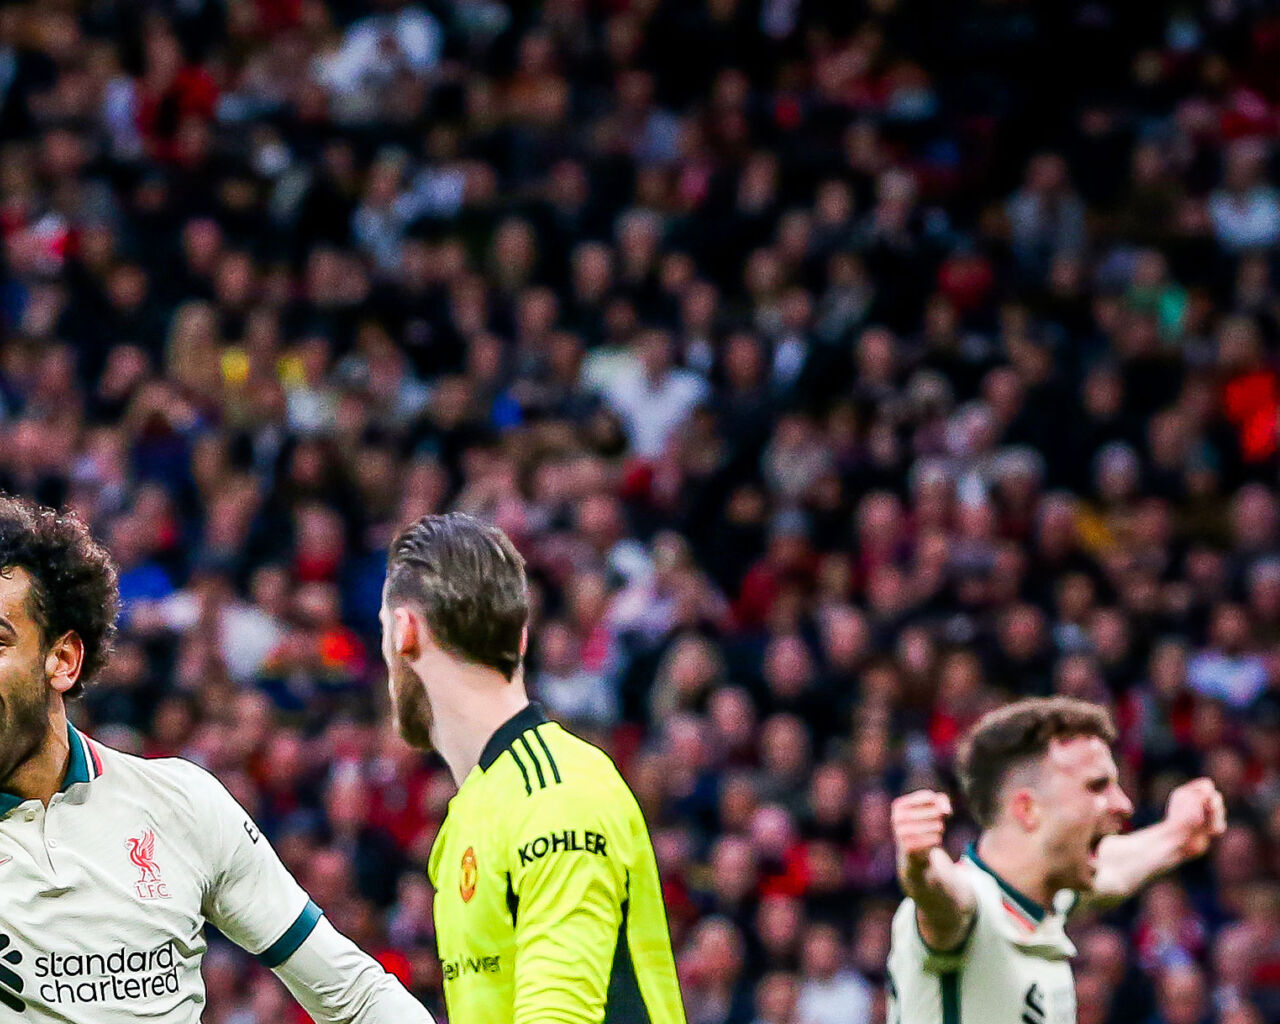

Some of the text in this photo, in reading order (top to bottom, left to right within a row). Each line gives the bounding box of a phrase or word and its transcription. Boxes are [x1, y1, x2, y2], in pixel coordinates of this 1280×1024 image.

[518, 830, 607, 867] KOHLER
[35, 942, 174, 977] standard
[40, 966, 179, 1003] chartered
